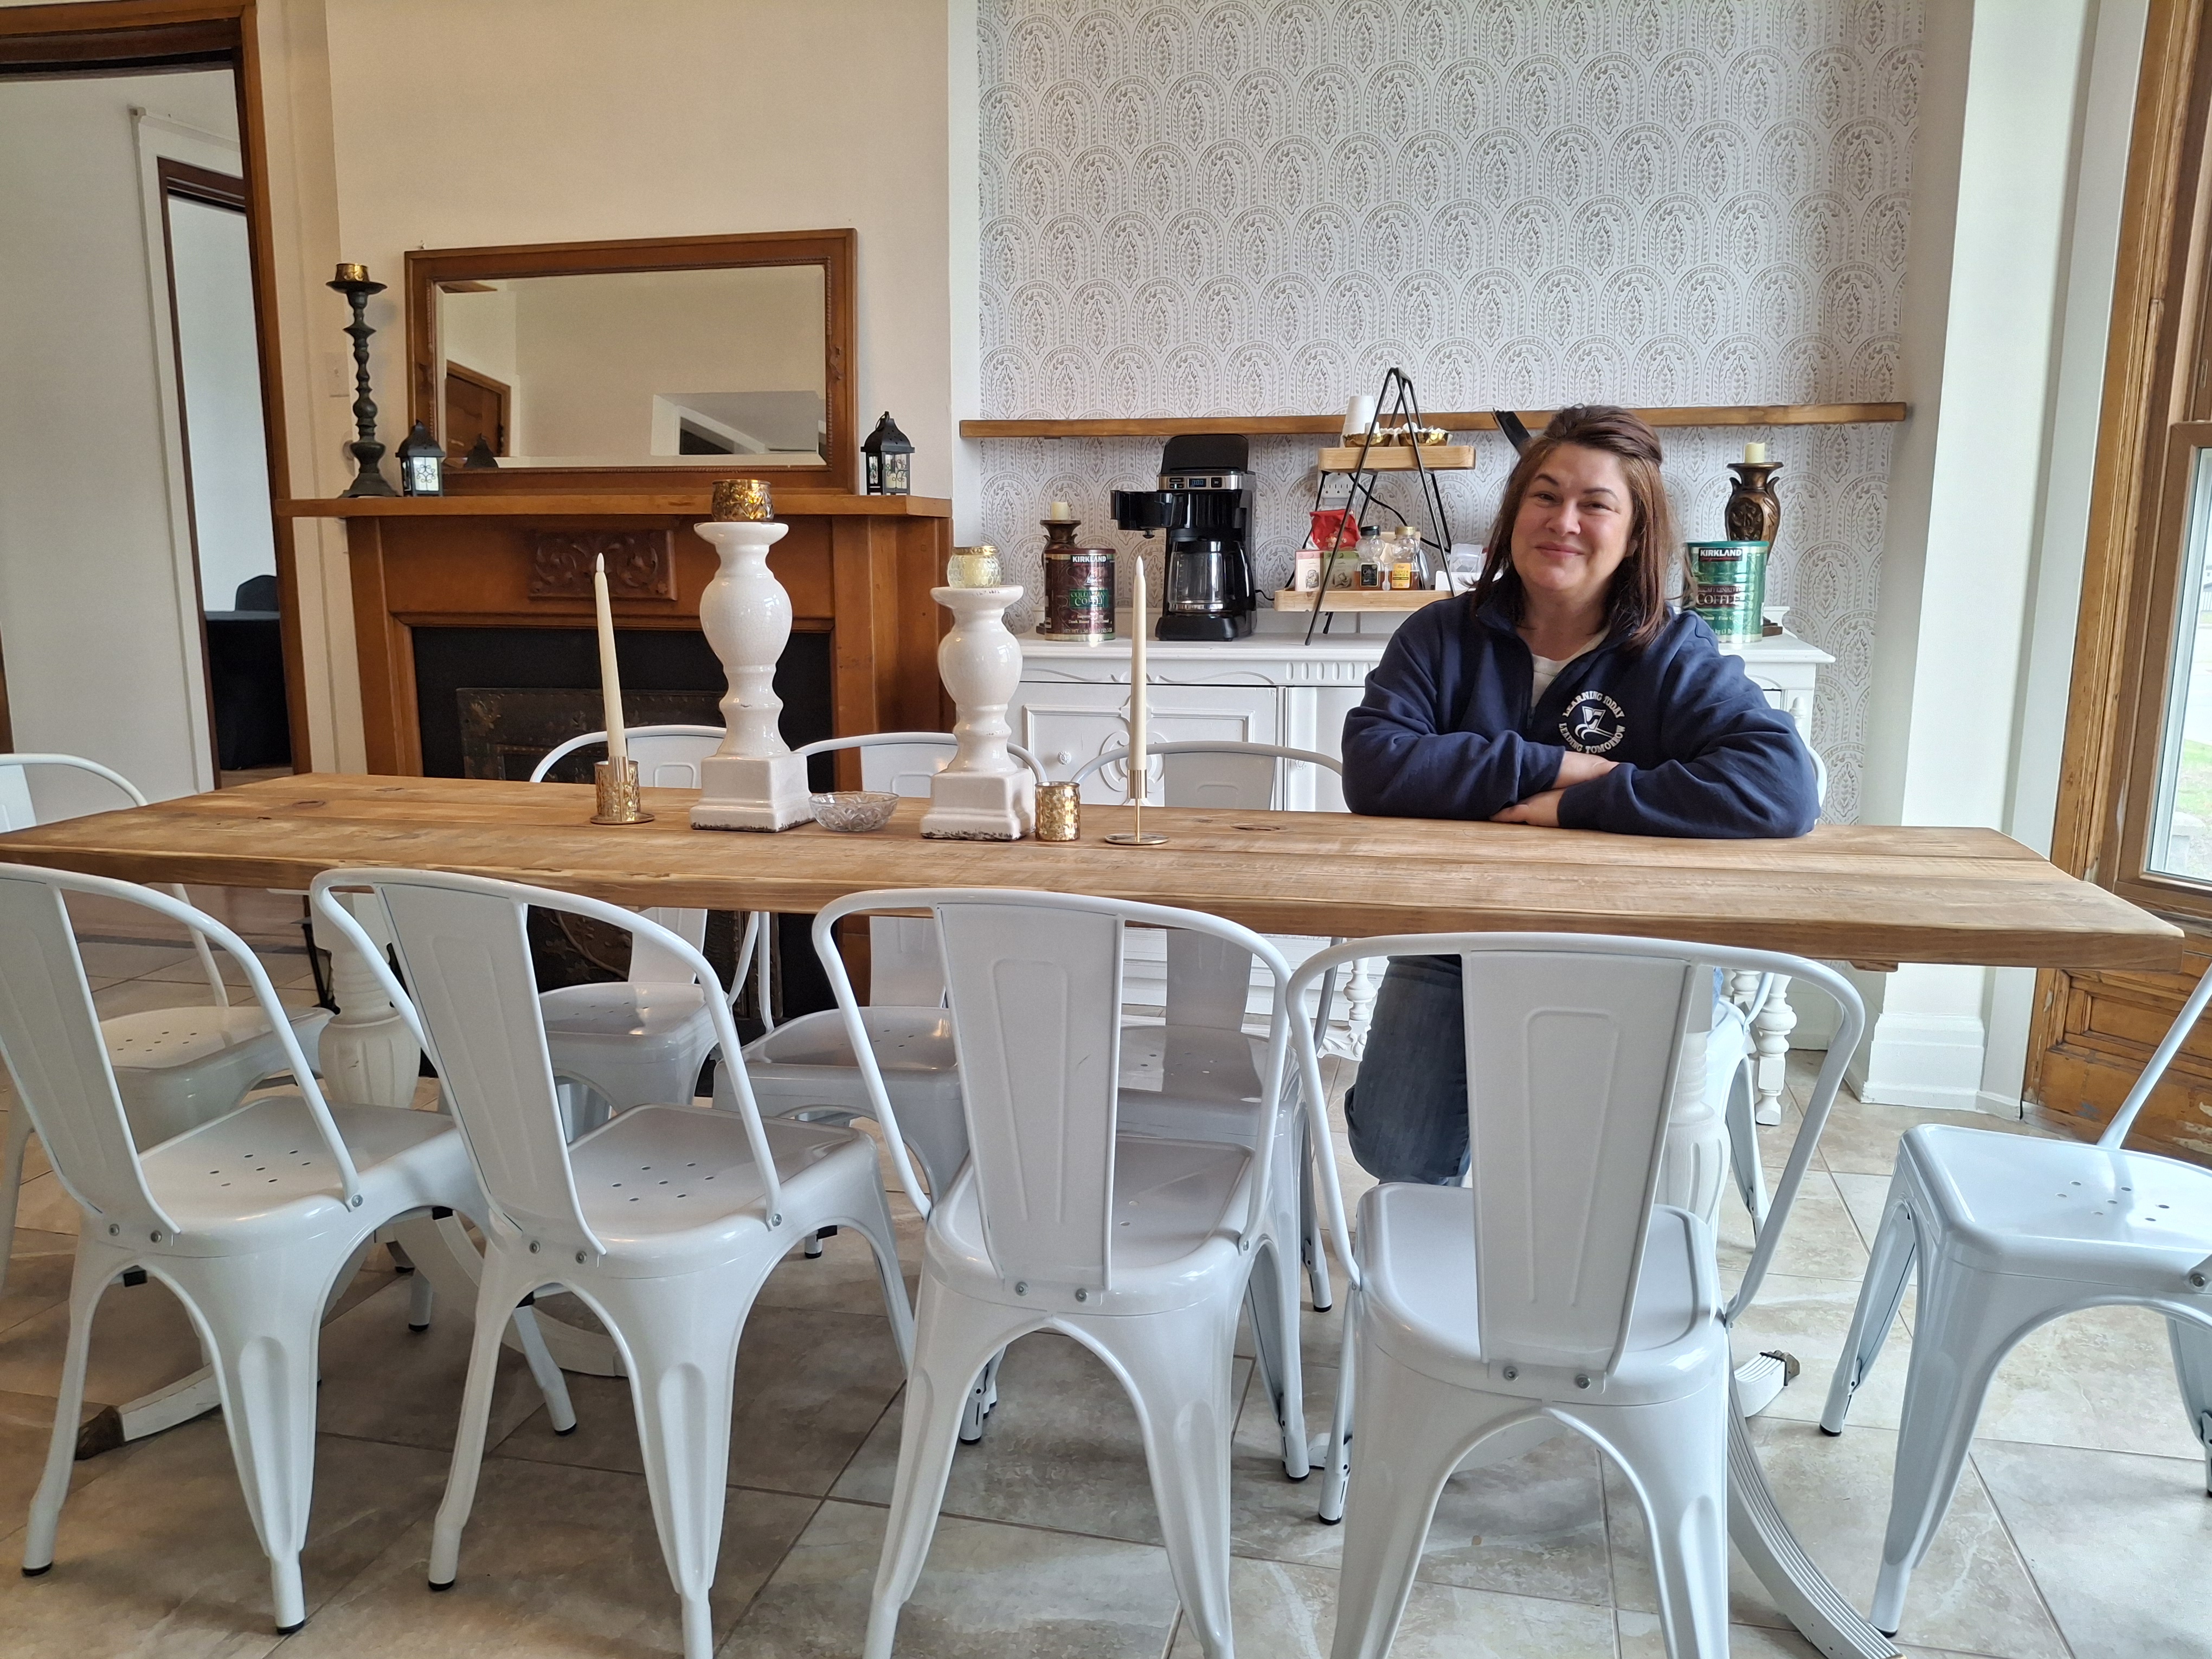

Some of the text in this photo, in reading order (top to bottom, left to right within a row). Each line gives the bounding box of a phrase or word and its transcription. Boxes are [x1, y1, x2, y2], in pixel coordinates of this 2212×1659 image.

[1696, 593, 1740, 606] COFFEE
[1562, 691, 1625, 718] LEARNING TODAY
[1559, 723, 1625, 754] LEADING TOMORROW
